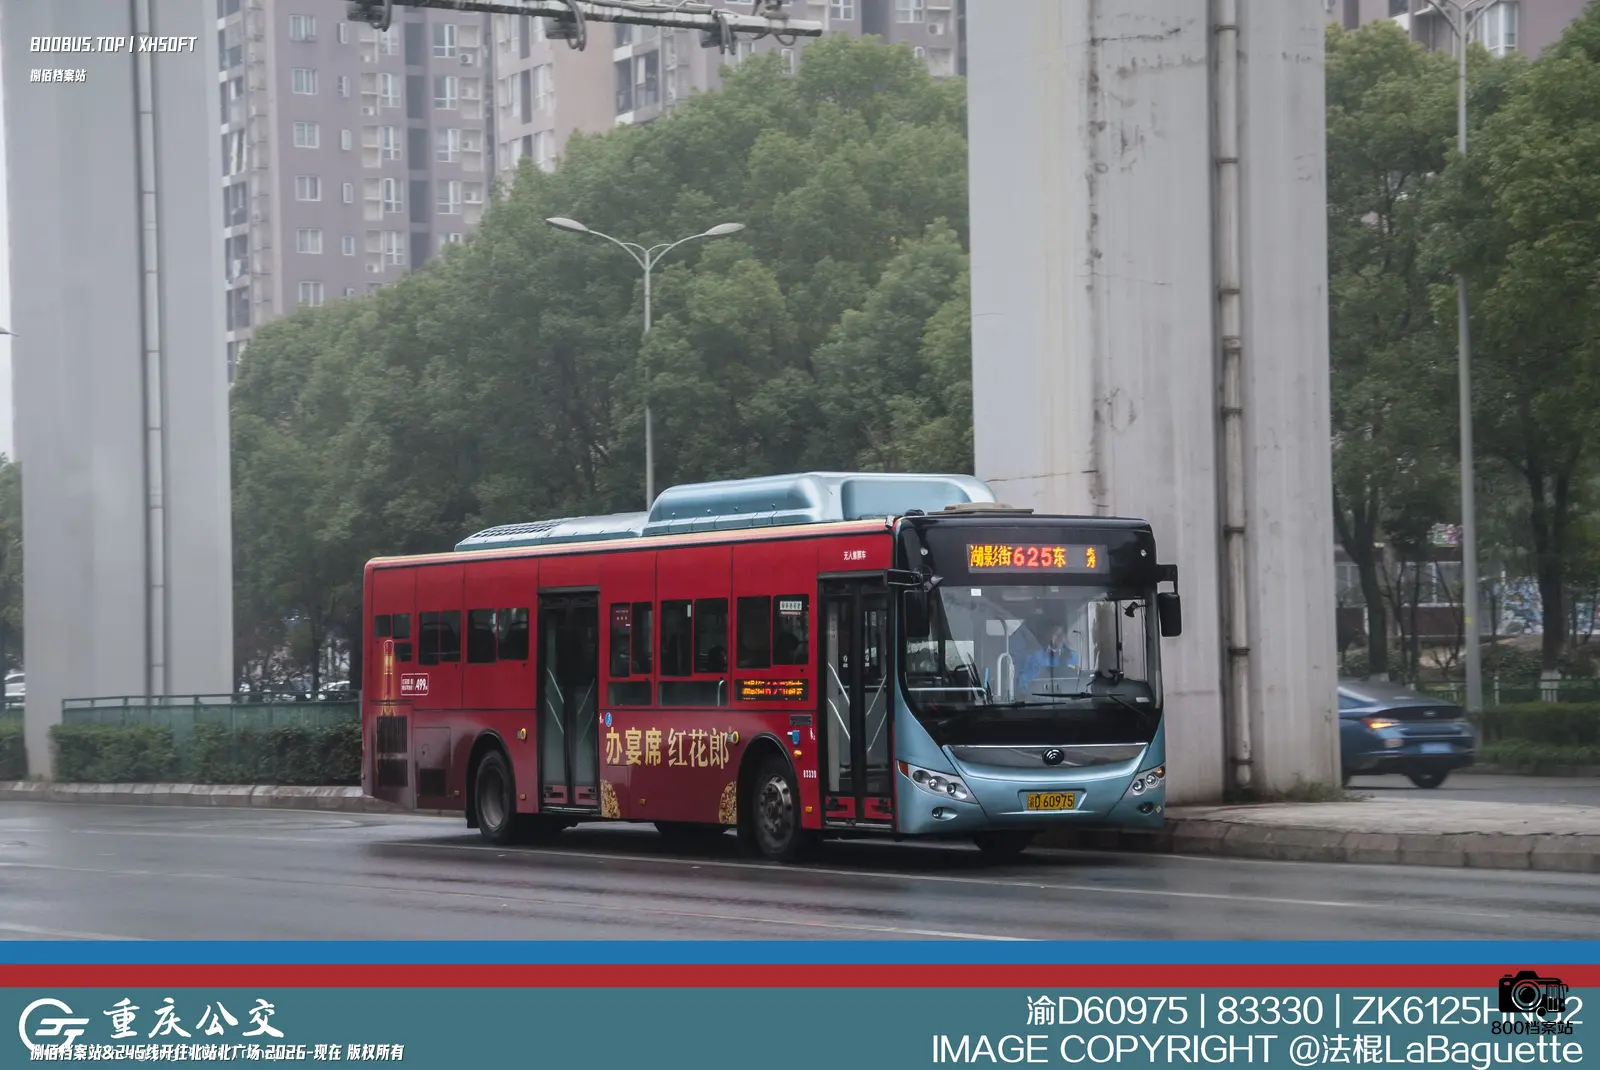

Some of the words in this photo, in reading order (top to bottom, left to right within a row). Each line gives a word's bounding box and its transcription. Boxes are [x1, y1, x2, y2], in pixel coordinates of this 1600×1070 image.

[606, 727, 662, 766] 办宴席
[667, 727, 730, 769] 红花郎
